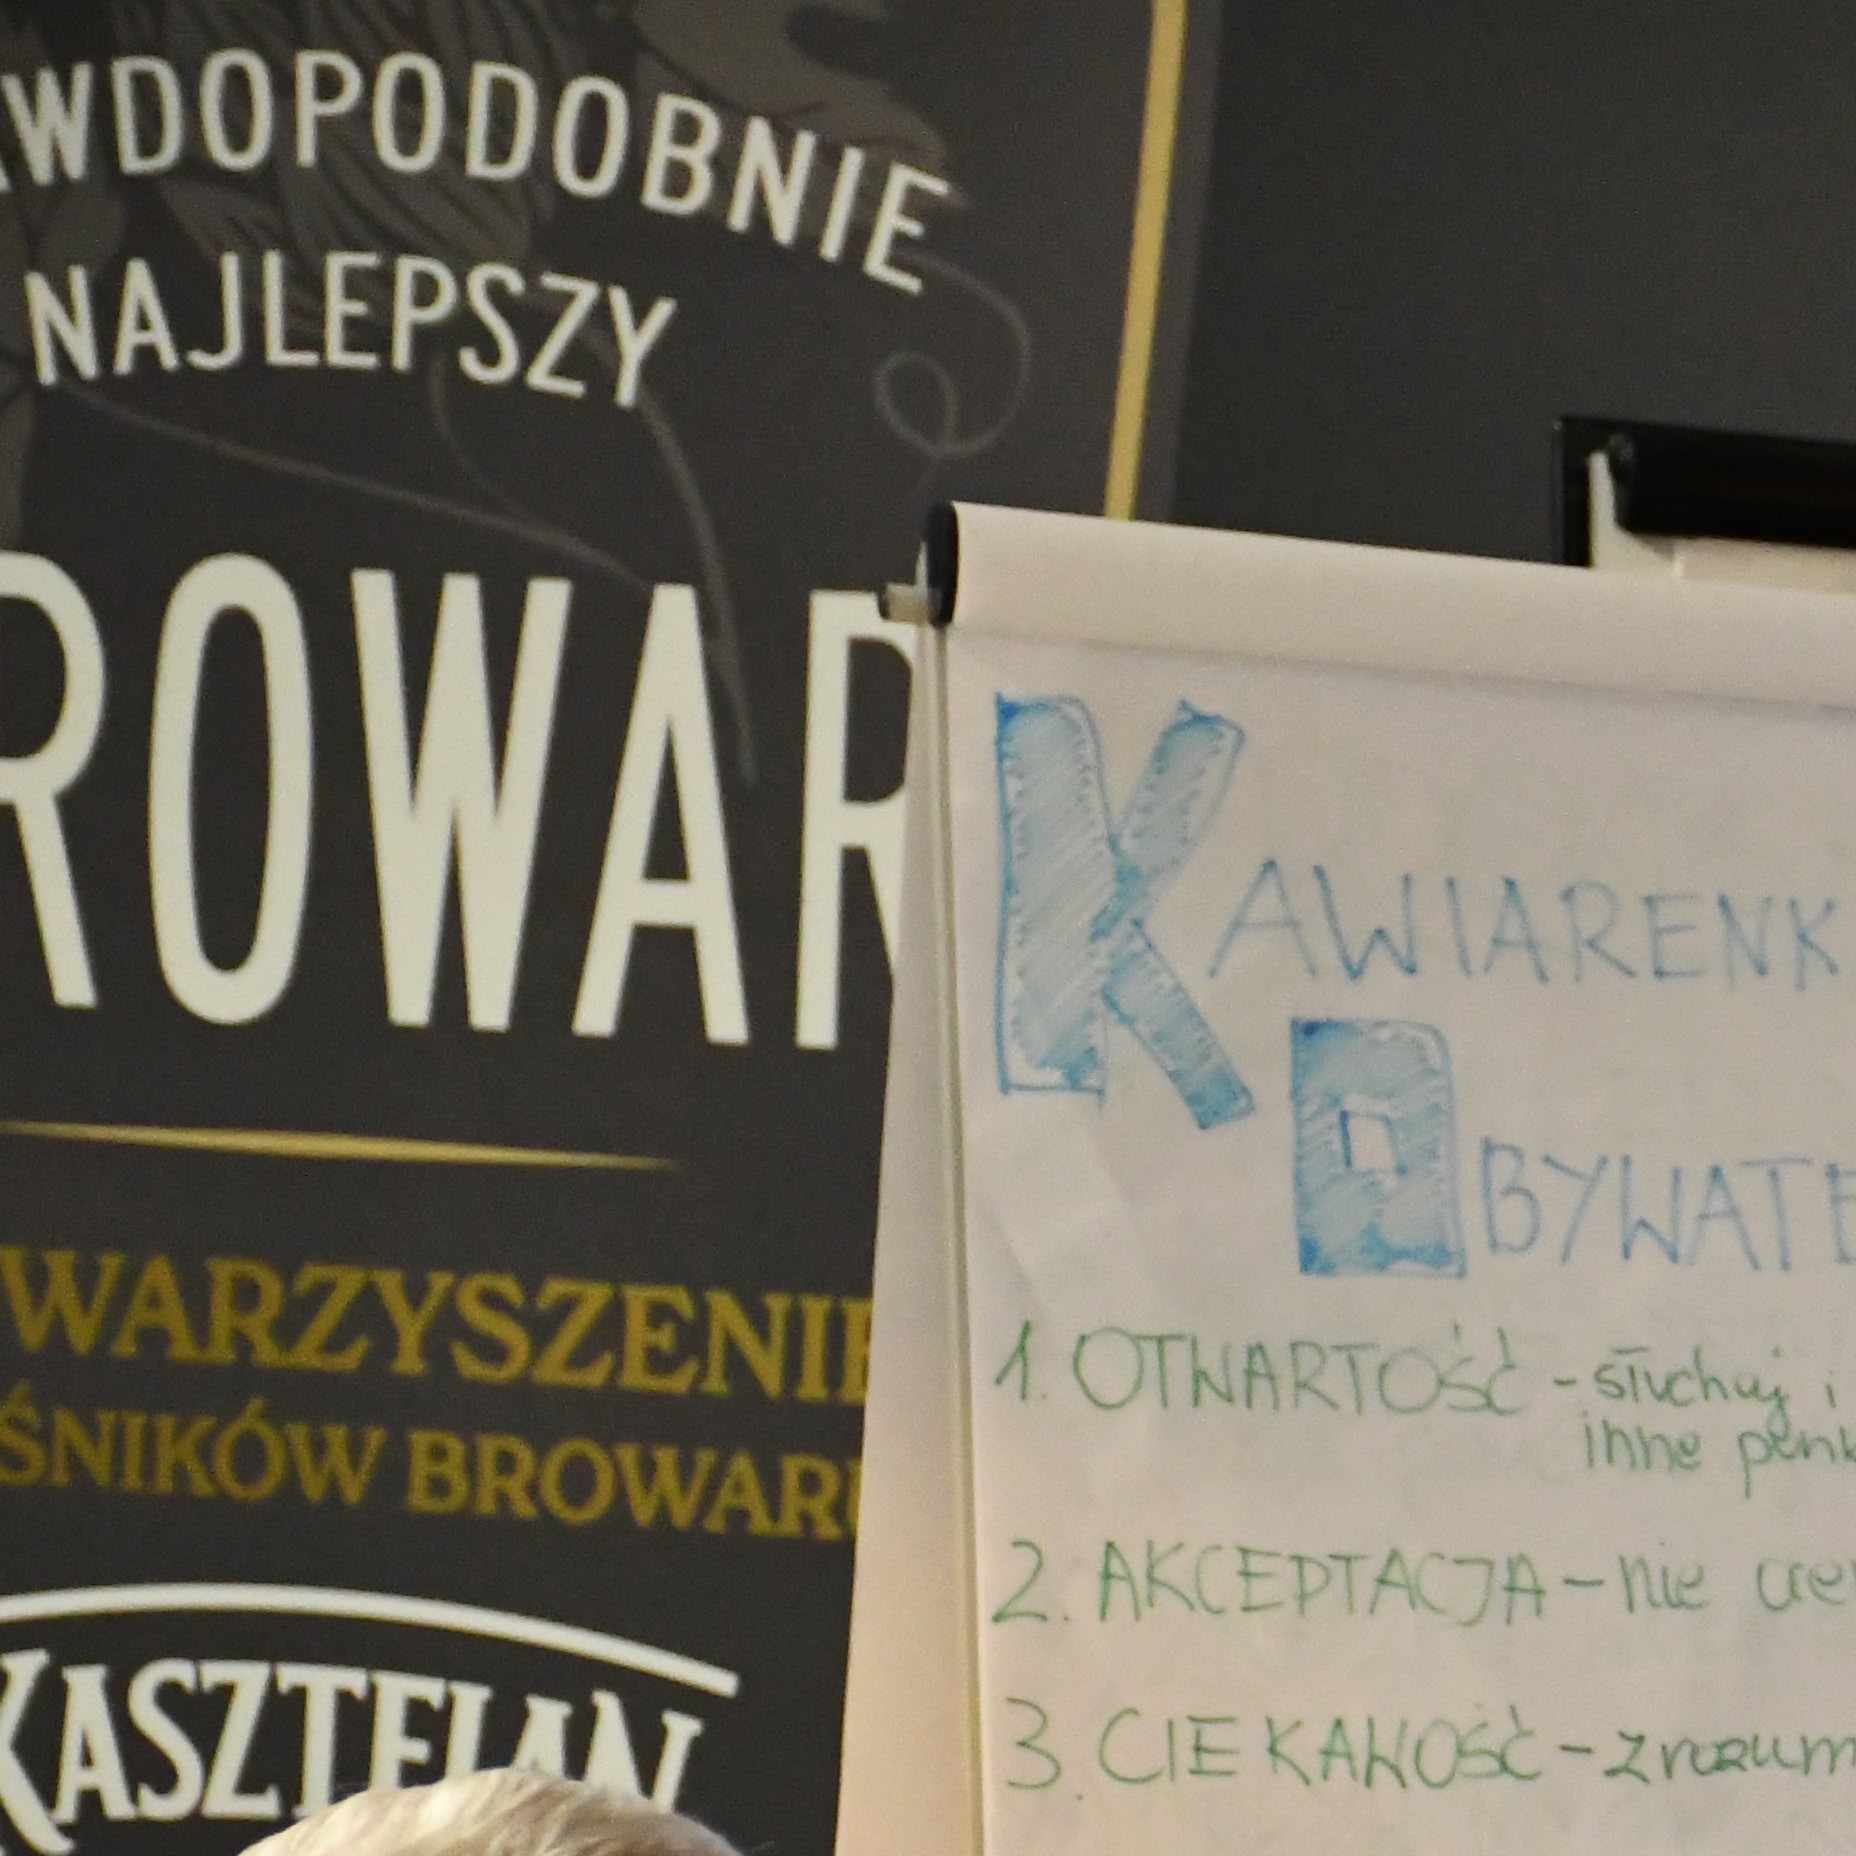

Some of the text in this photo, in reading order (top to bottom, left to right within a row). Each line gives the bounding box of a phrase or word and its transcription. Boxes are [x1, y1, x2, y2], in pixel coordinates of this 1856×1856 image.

[0, 48, 951, 295] WDOPODOBNIE
[24, 250, 676, 407] NAJLEPSZY
[0, 1379, 863, 1541] ŚNIKÓW BROWAR
[1100, 1540, 1547, 1627] AKCEPTACJA
